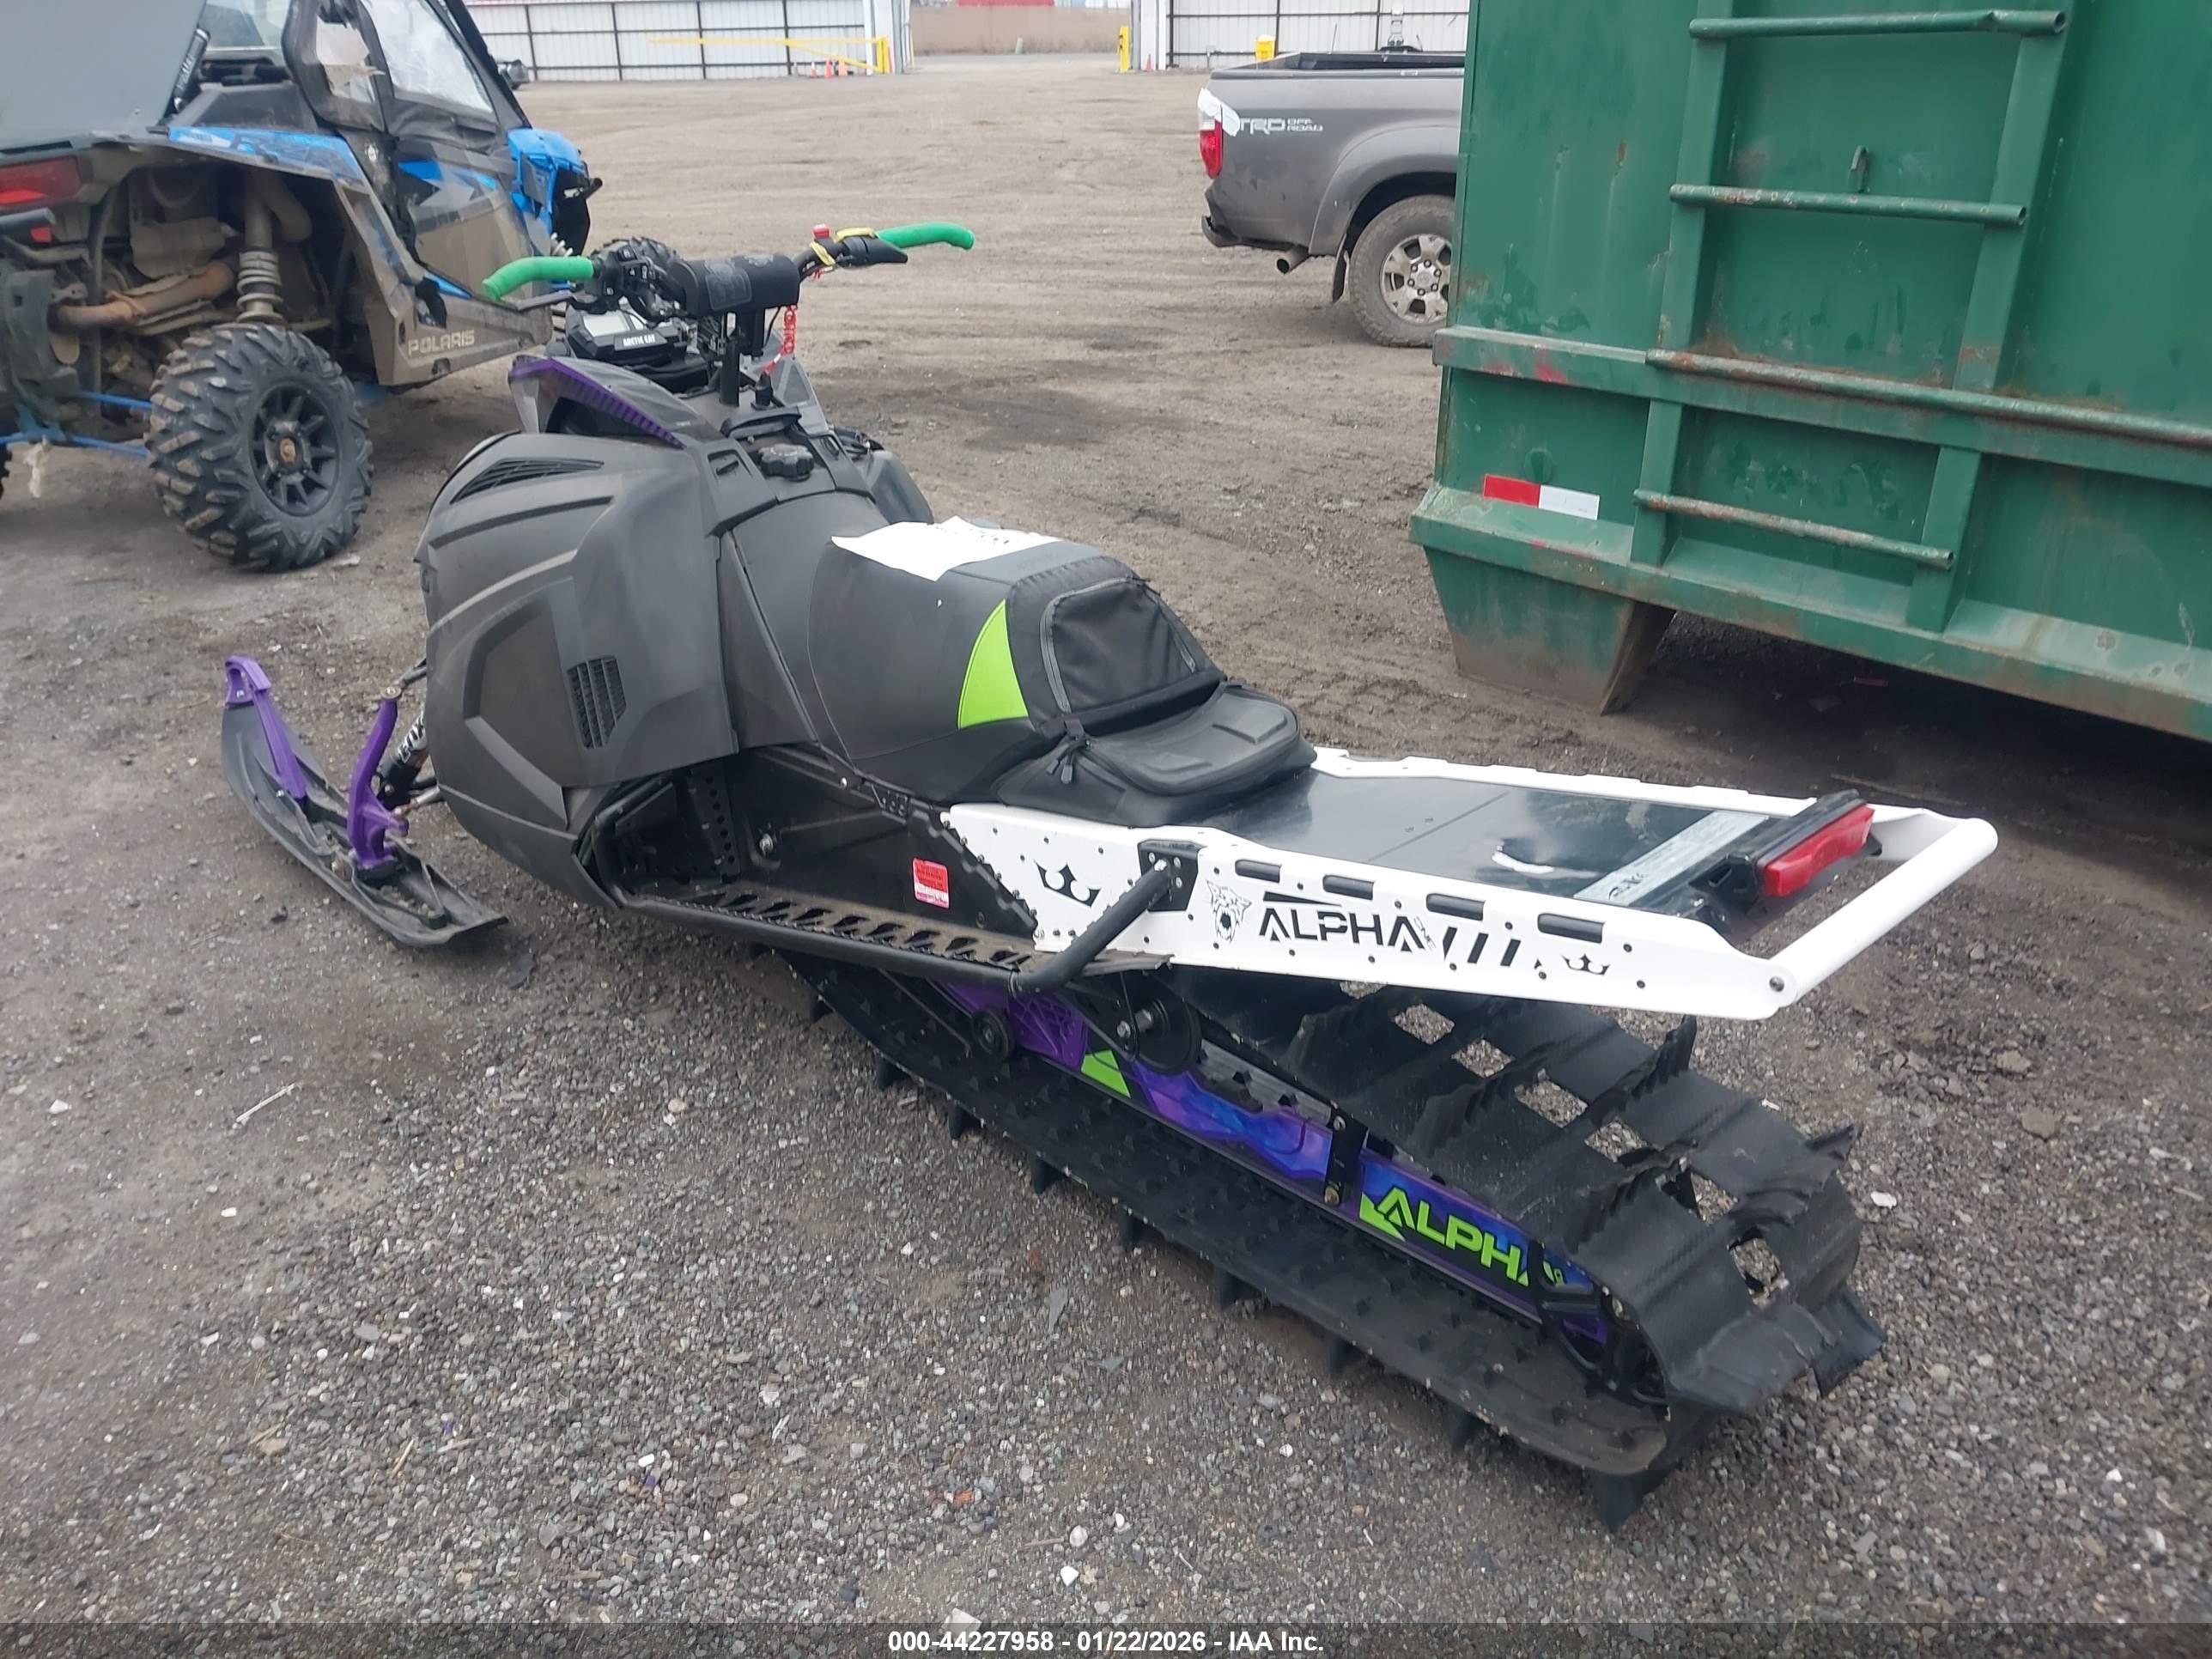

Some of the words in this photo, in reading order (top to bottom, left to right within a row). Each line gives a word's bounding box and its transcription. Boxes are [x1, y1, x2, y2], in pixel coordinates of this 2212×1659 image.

[1239, 118, 1286, 135] TRD
[408, 329, 475, 356] POLARIS
[1259, 908, 1425, 952] ALPHA
[1376, 1187, 1530, 1287] ALPH
